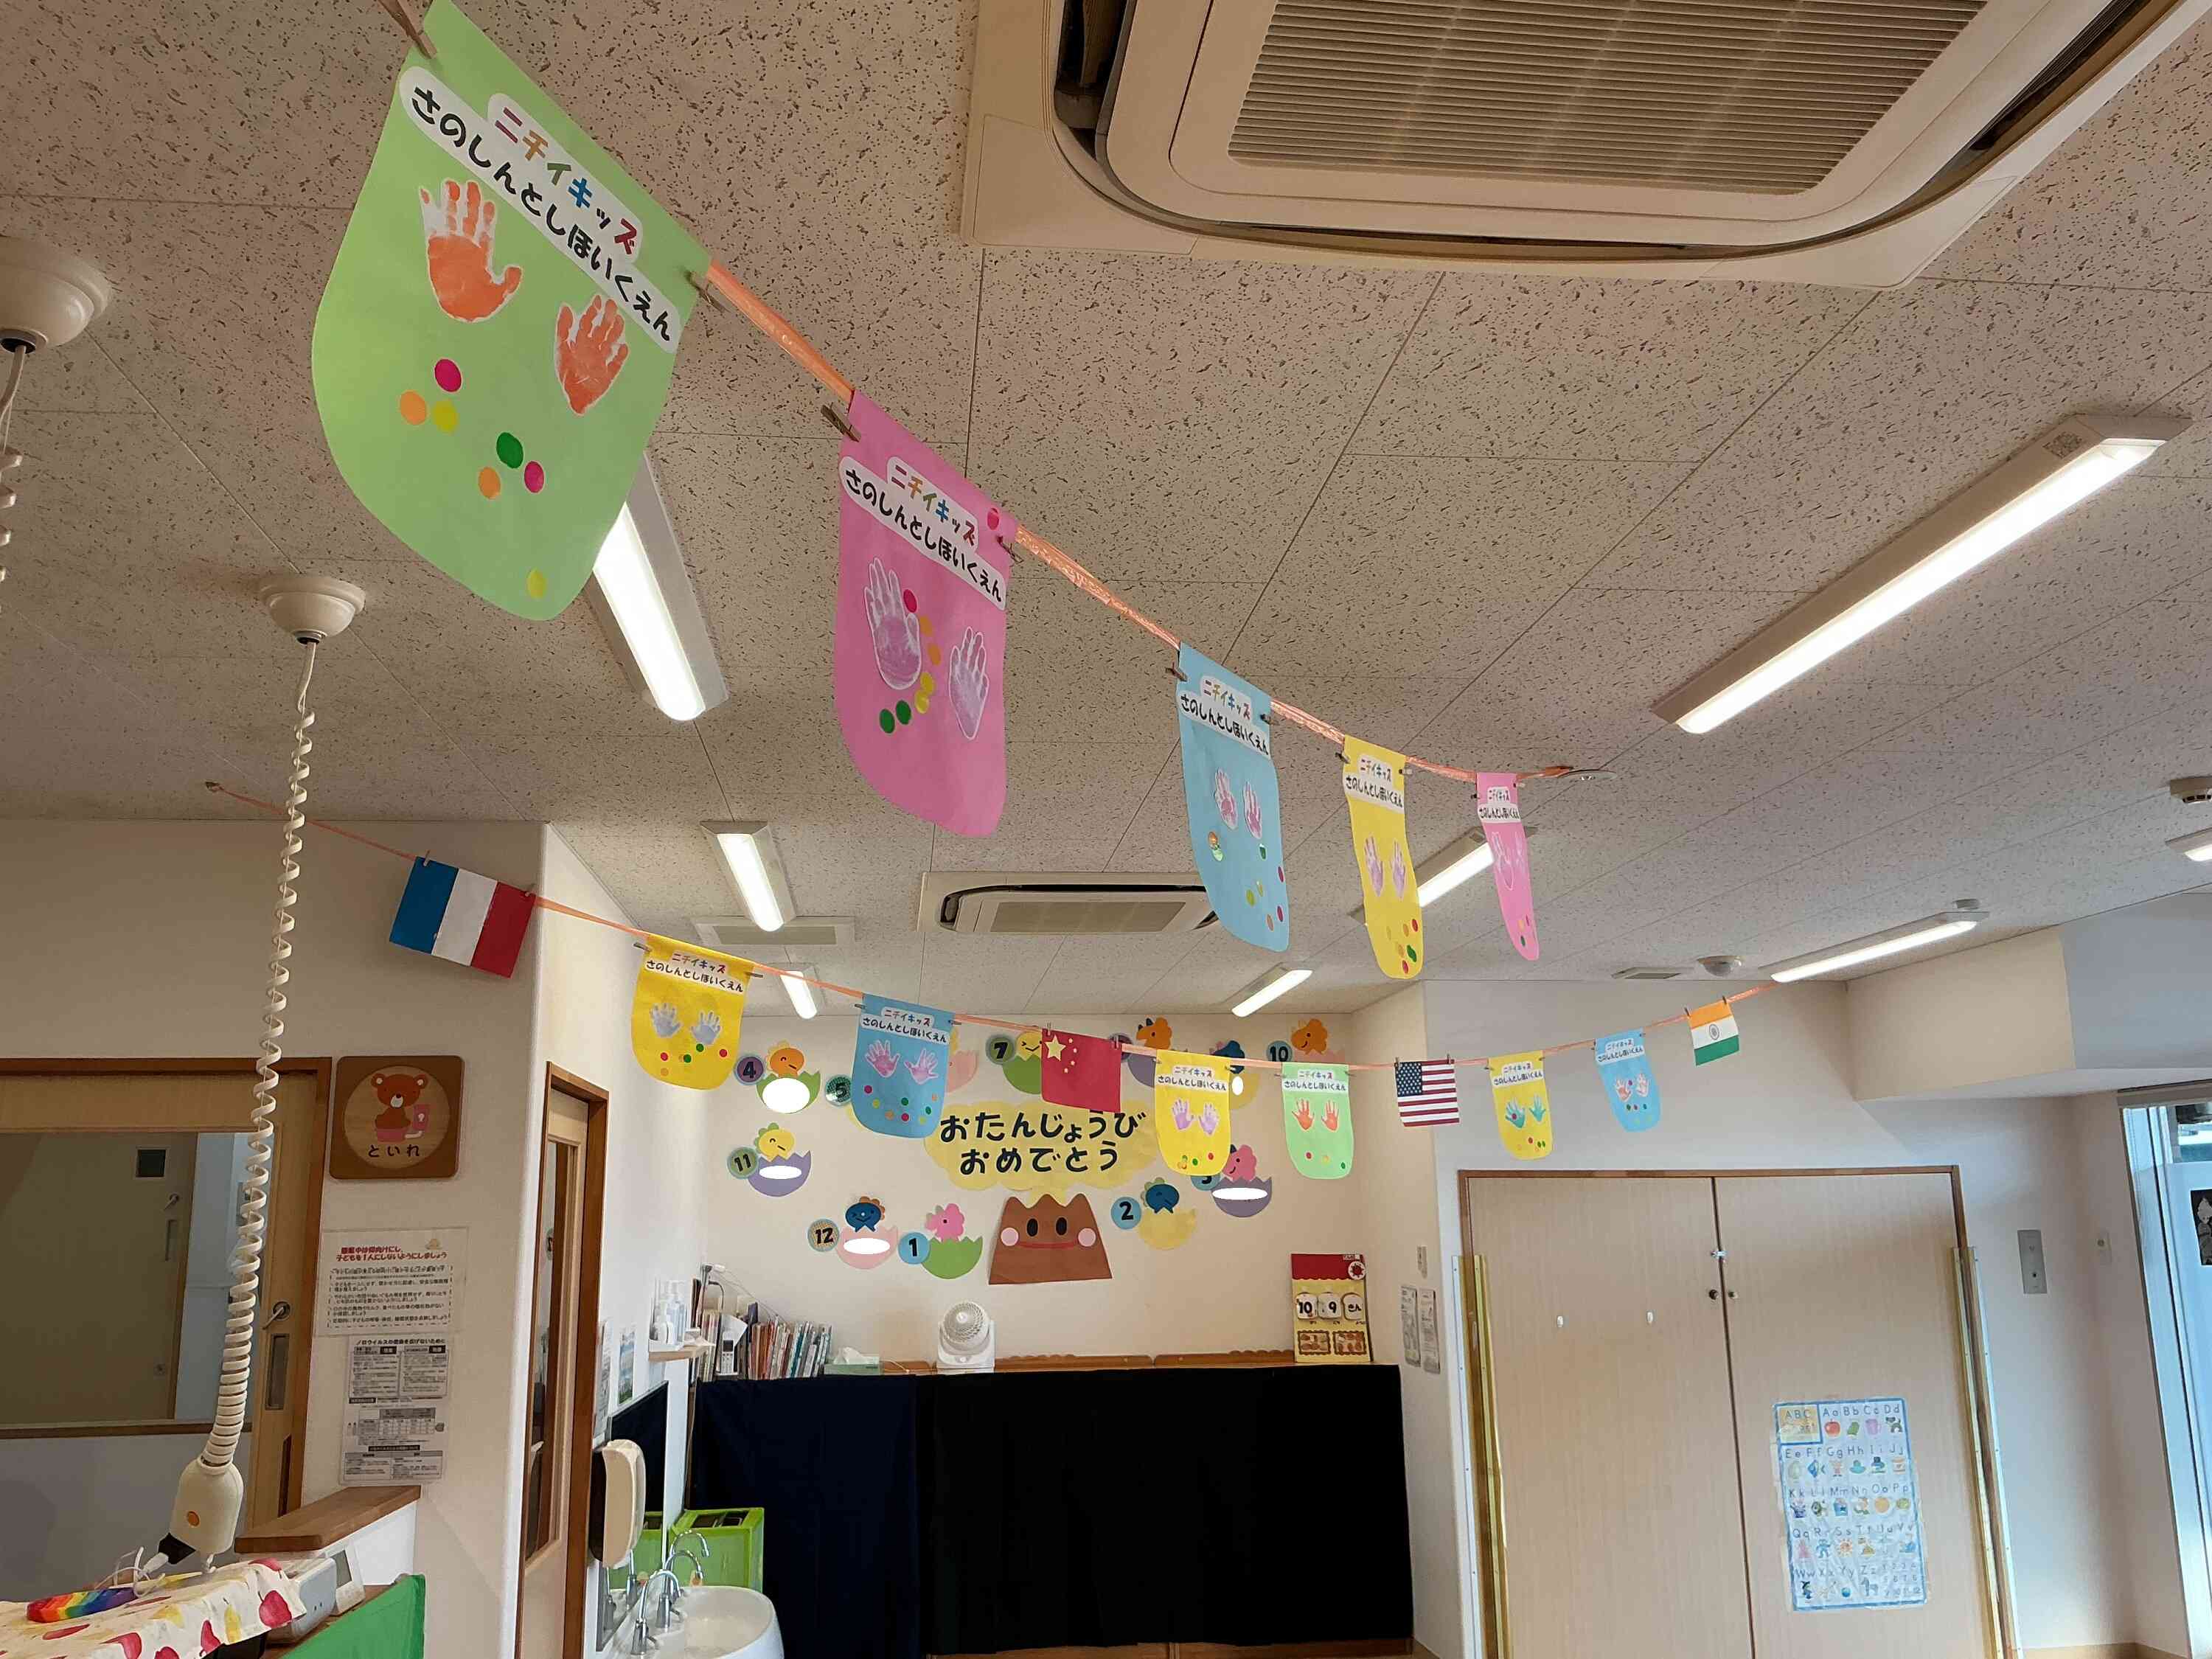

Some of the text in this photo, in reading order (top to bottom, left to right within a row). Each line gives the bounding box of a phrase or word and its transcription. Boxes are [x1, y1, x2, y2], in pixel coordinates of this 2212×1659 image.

[495, 107, 637, 254] ニチイキッズ
[411, 86, 670, 341] さのしんとしほいくえん
[891, 465, 975, 546] ニチイキッズ
[846, 470, 1001, 602] さのしんとしほいくえん
[1204, 680, 1250, 720] ニチイキッズ
[1180, 694, 1268, 755] さのしんとしほいくえん
[672, 953, 726, 973] ニチイキッズ
[647, 960, 742, 992] さのしんとしほいくえん
[885, 1009, 930, 1026] ニチイキッズ
[863, 1018, 947, 1043] さのしんとしほいくえん
[994, 1042, 1008, 1059] 7
[1270, 1046, 1288, 1062] 10
[742, 1061, 757, 1079] 4
[835, 1082, 846, 1098] 5
[940, 1110, 1146, 1143] おたんじょうび
[369, 1144, 420, 1158] といれ
[960, 1141, 1118, 1175] おめでとう
[734, 1153, 751, 1172] 11
[1119, 1201, 1134, 1220] 2
[815, 1227, 834, 1245] 12
[908, 1238, 918, 1256] 1
[1298, 1301, 1312, 1313] 10
[1329, 1301, 1337, 1313] 9
